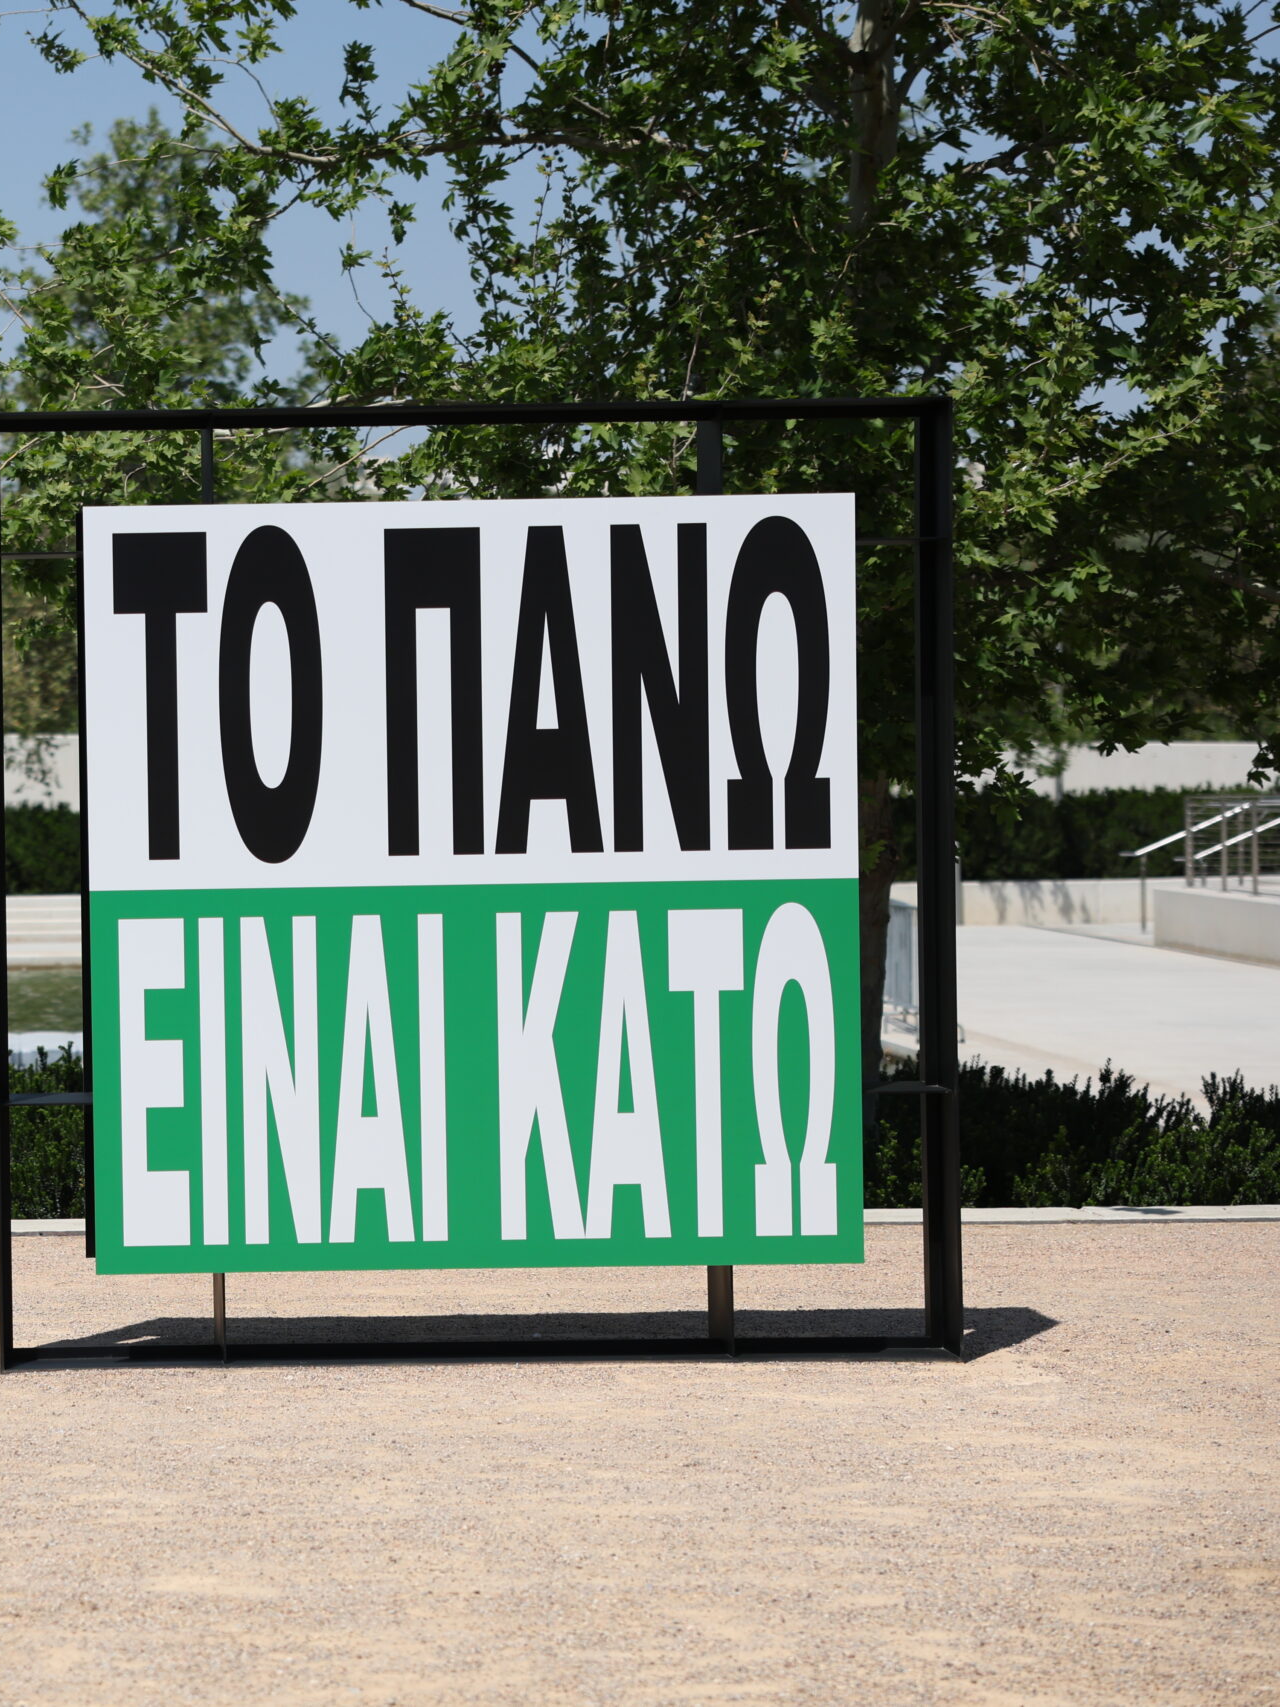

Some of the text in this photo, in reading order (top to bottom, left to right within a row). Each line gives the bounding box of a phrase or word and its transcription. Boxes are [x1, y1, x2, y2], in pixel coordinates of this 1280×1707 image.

[112, 515, 832, 864] ΤΟ ΠΑΝΩ
[118, 902, 839, 1247] ΕΙΝΑΙ ΚΑΤΩ
